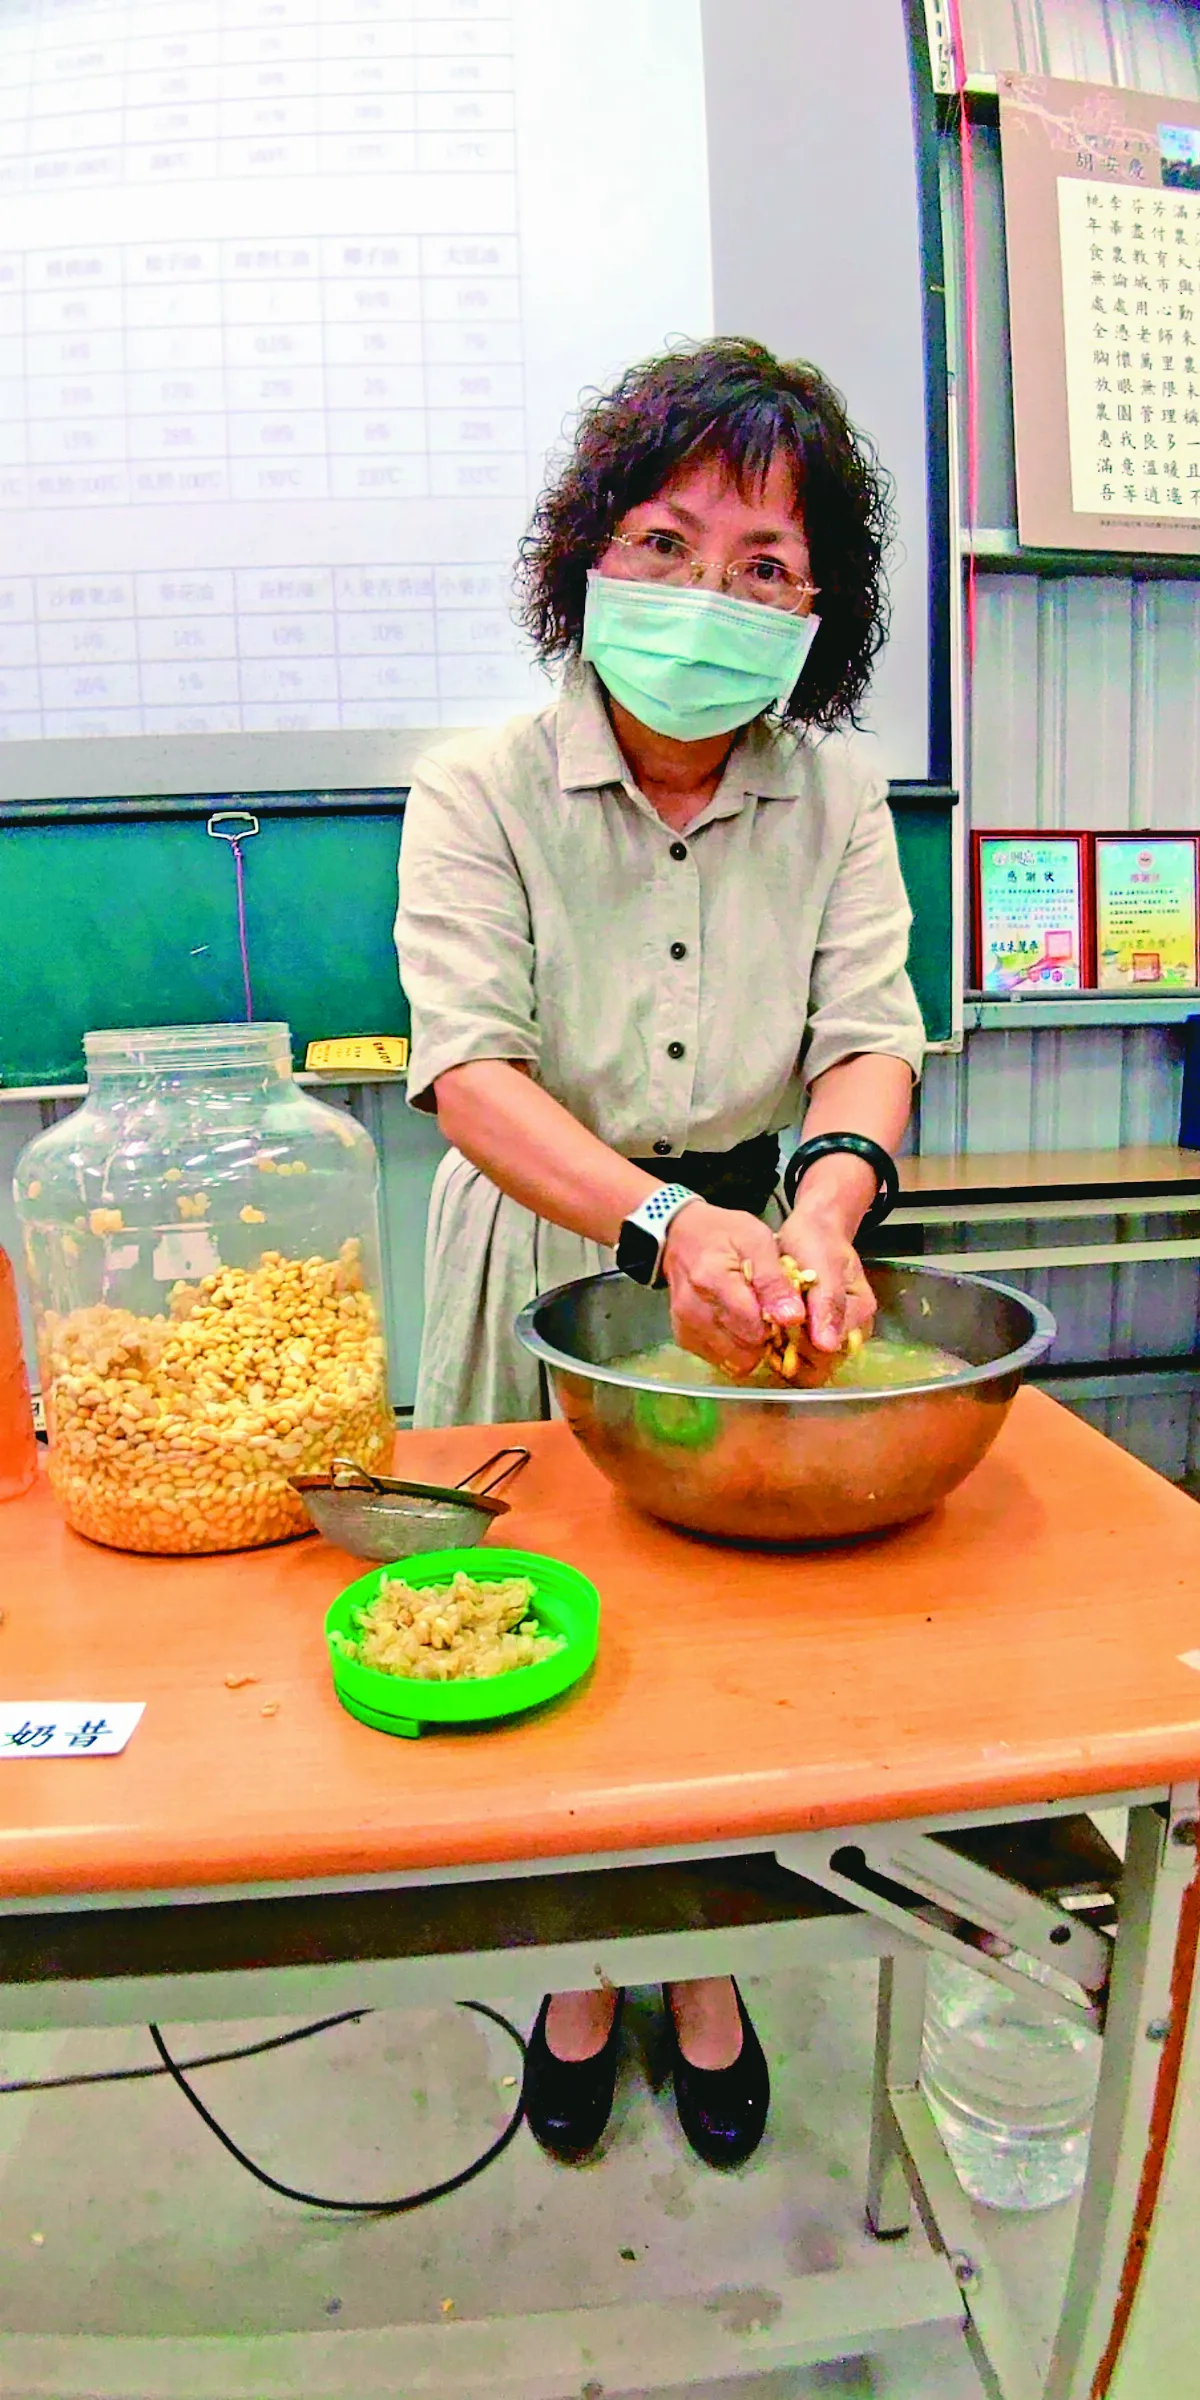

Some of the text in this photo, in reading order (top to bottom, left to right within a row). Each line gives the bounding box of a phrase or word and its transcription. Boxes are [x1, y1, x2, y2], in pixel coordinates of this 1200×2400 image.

[1086, 217, 1200, 246] 年華盡付農
[1089, 243, 1200, 271] 食農教育大
[0, 1719, 113, 1748] 奶昔
